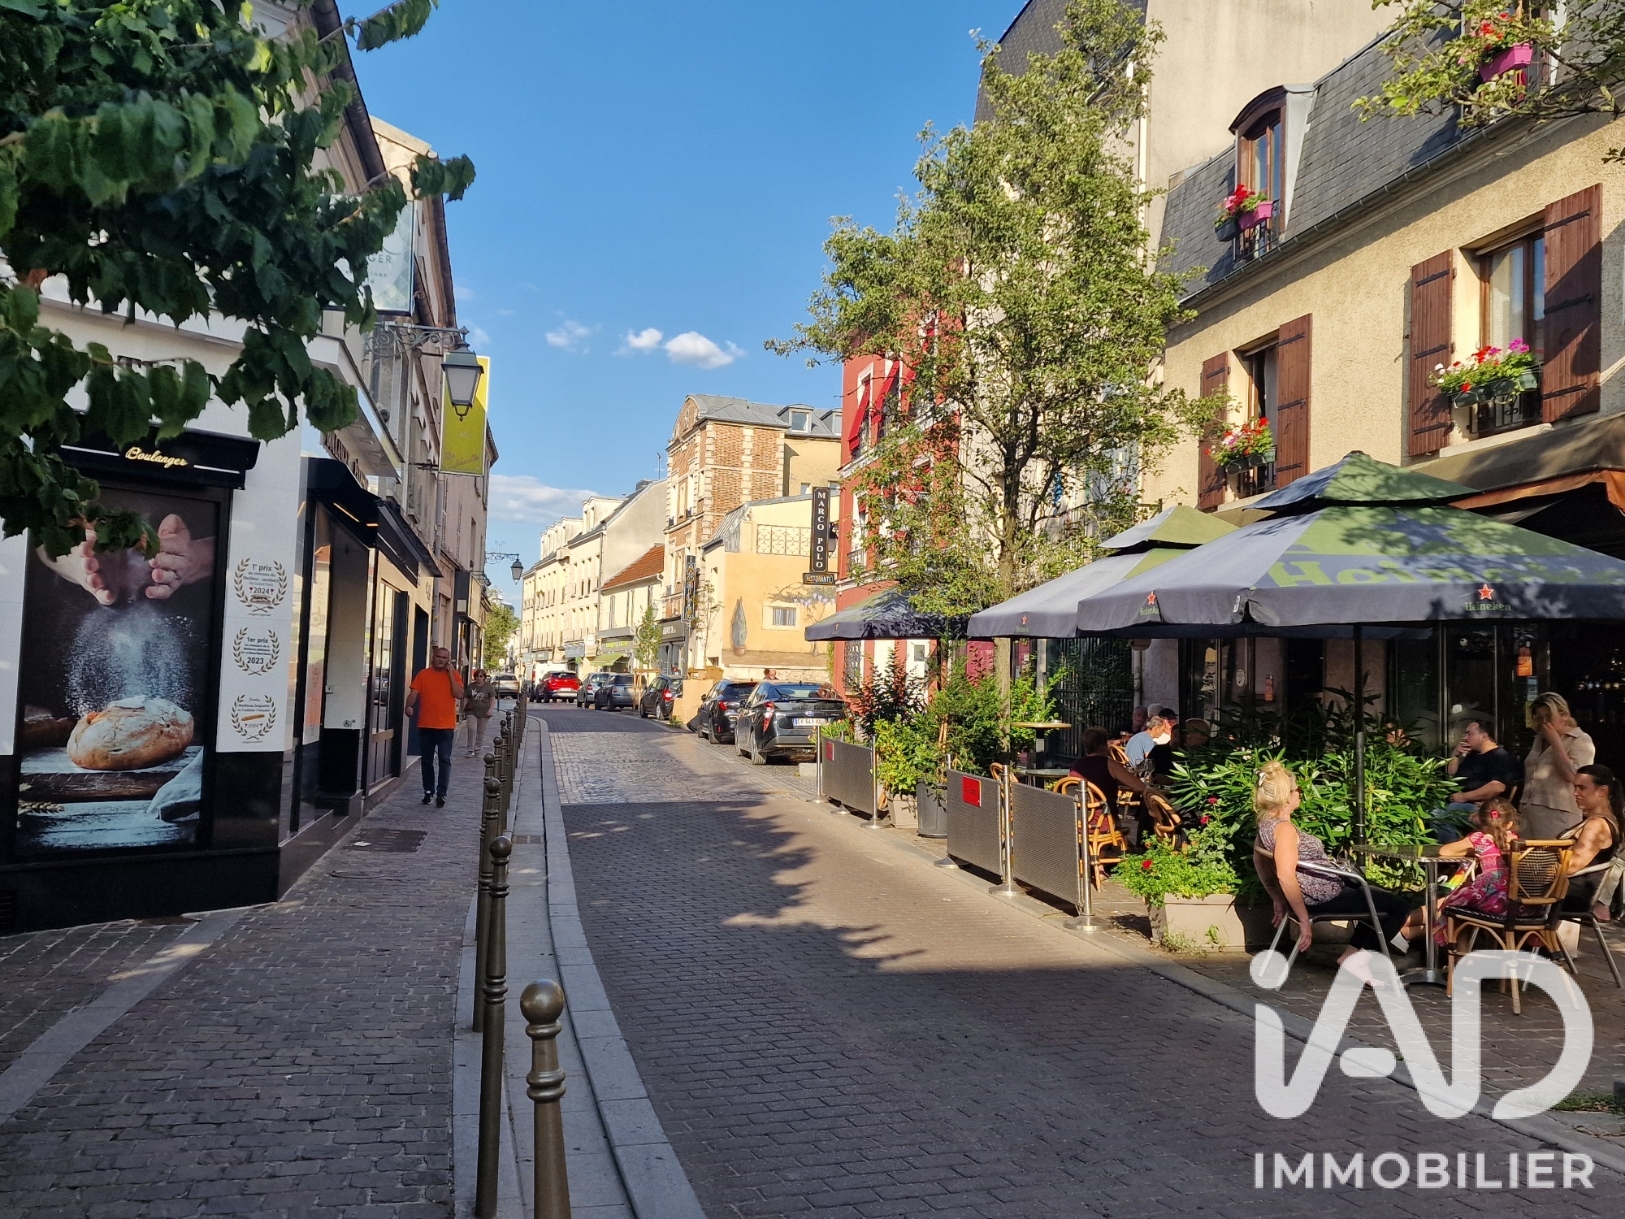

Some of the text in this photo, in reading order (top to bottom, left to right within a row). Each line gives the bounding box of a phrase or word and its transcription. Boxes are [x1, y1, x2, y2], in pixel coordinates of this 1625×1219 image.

[125, 446, 189, 469] Boulanger
[815, 492, 826, 568] MARCO POLO
[258, 564, 272, 572] prix
[1464, 602, 1512, 612] Heineken
[246, 656, 264, 665] 2023
